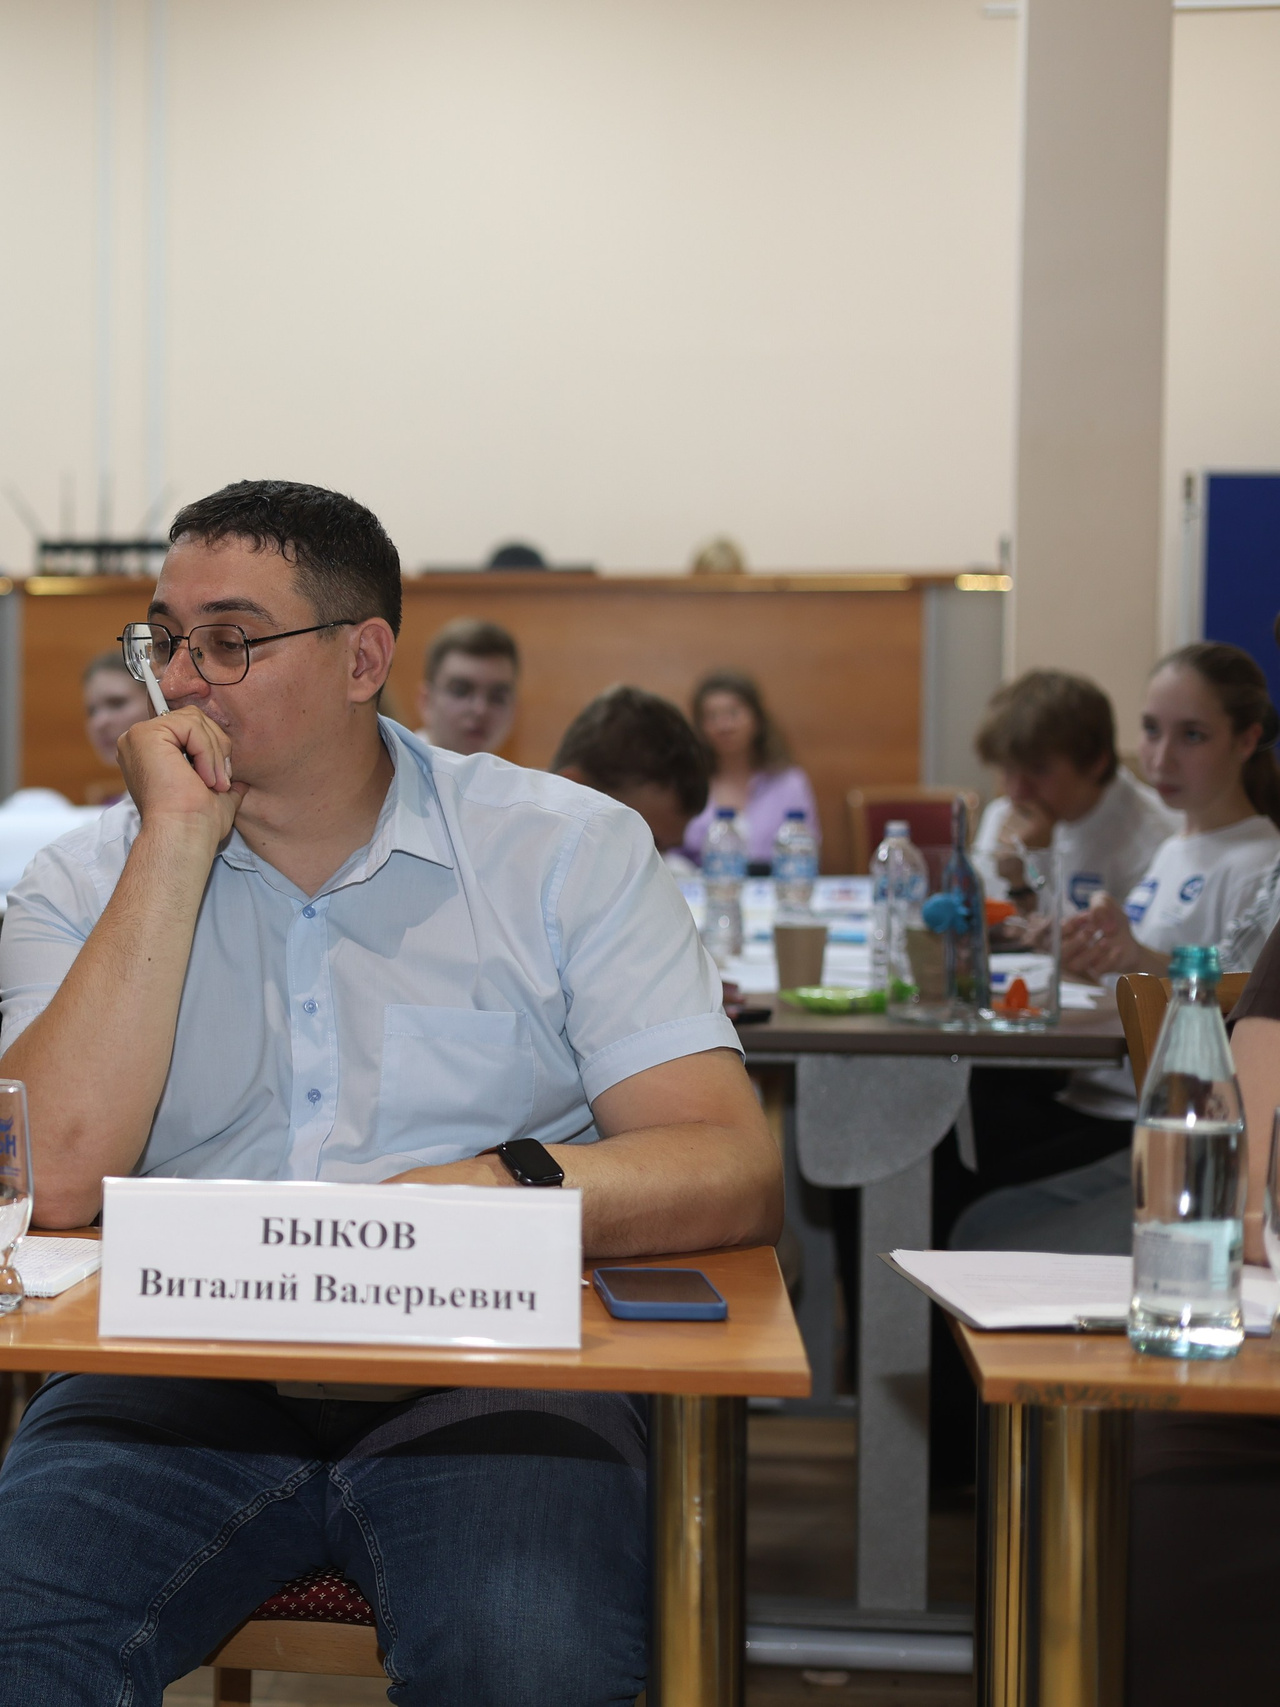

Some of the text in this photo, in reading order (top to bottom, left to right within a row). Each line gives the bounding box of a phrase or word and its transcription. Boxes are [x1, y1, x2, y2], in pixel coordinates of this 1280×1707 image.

[260, 1216, 417, 1250] БЫКОВ
[138, 1267, 537, 1314] Виталий Валерьевич
